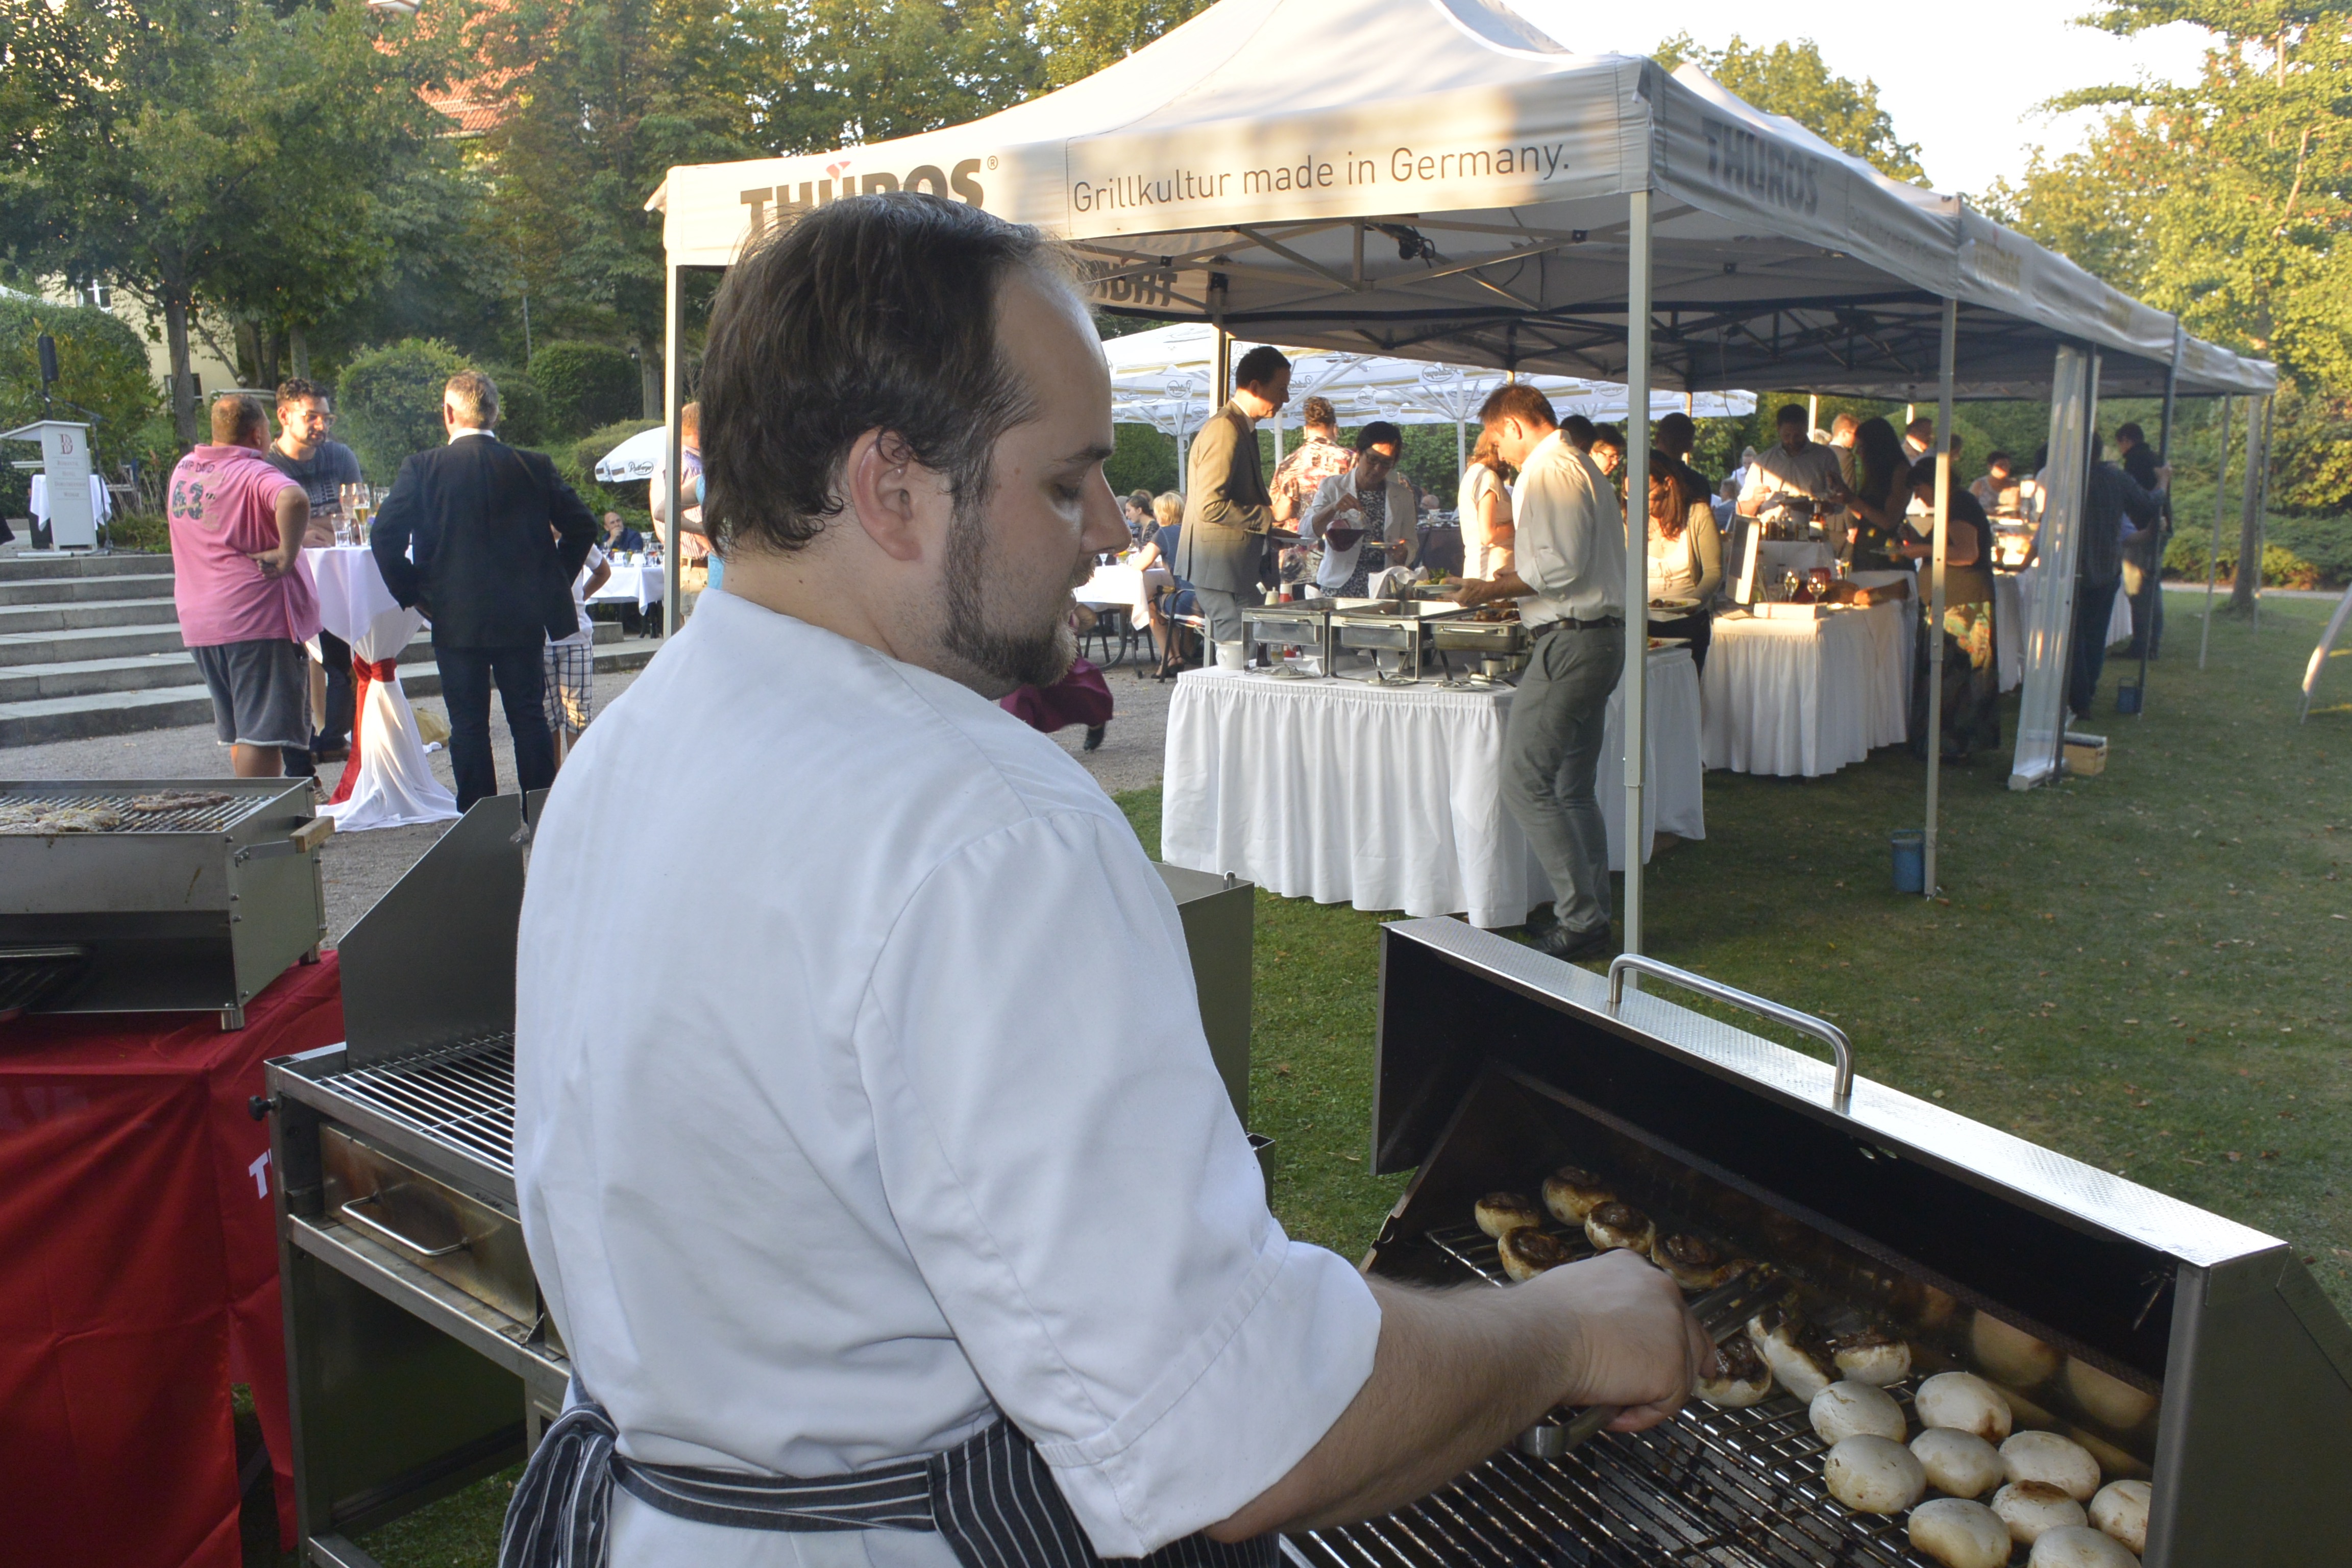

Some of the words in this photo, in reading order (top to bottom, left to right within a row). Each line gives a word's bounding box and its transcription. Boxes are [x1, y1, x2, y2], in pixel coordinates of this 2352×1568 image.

[1074, 168, 1231, 212] Grillkultur
[1243, 155, 1334, 194] made
[1348, 151, 1376, 185] in
[1391, 144, 1569, 181] Germany.
[173, 480, 204, 520] 63
[249, 1147, 272, 1199] T
